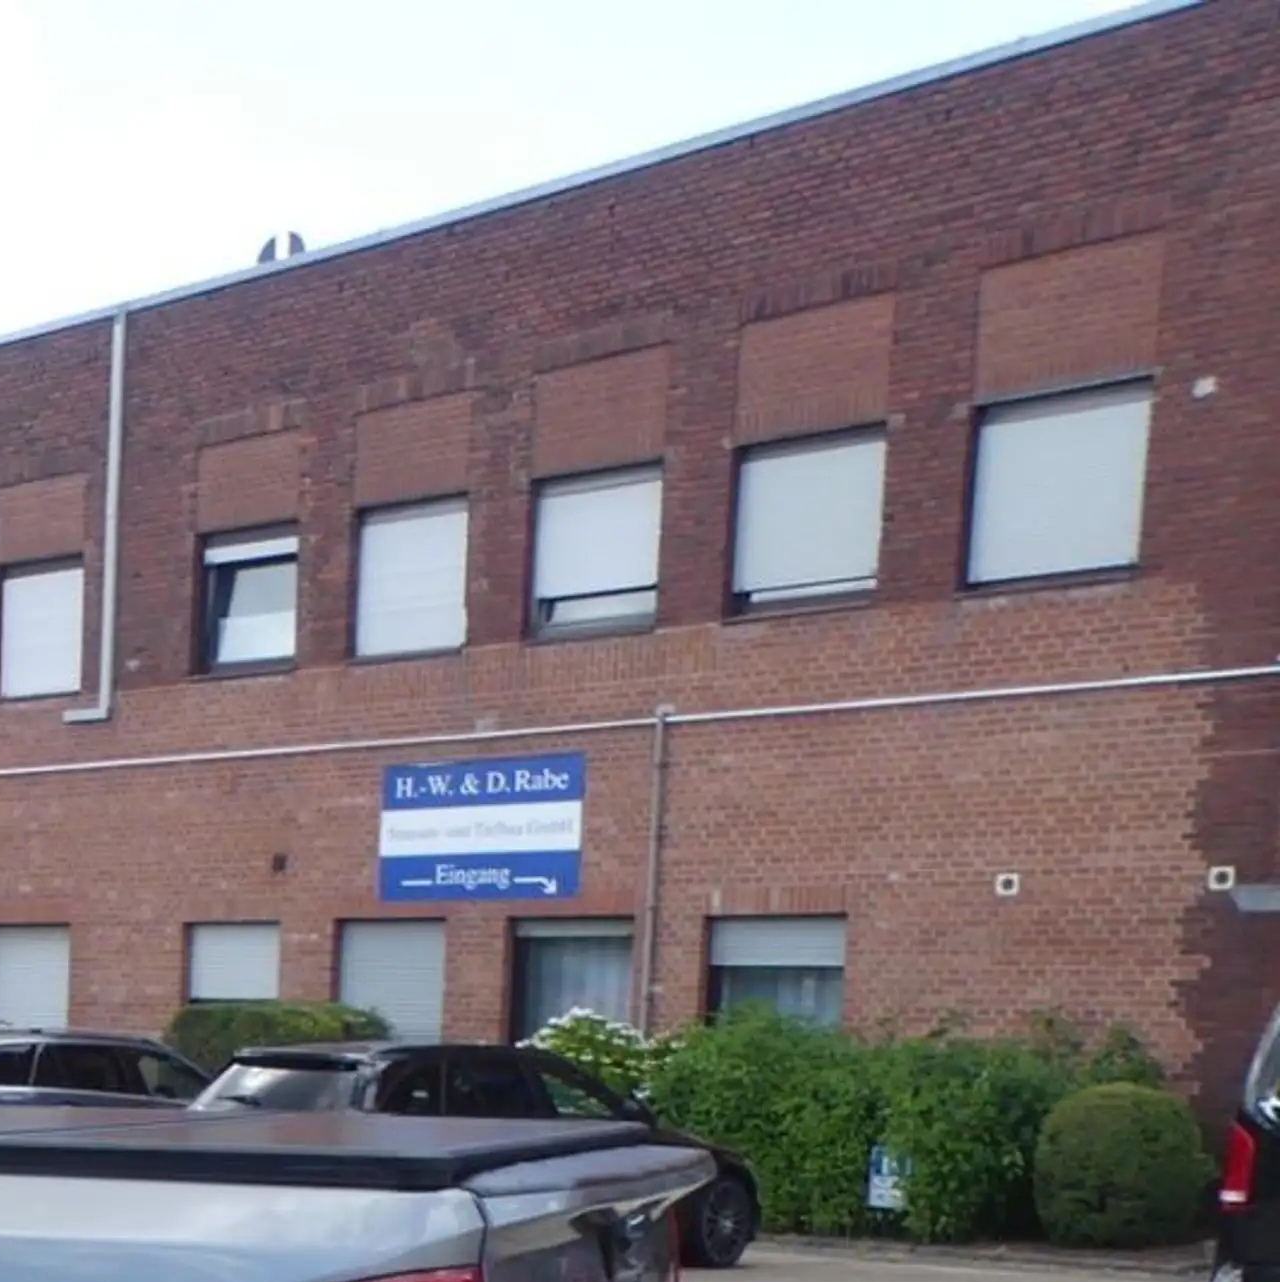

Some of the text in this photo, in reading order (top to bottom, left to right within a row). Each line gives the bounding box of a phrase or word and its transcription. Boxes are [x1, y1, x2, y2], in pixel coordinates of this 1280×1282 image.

[460, 772, 480, 796] &
[485, 770, 511, 794] D.
[514, 767, 570, 792] Rabe
[435, 863, 511, 890] Eingang
